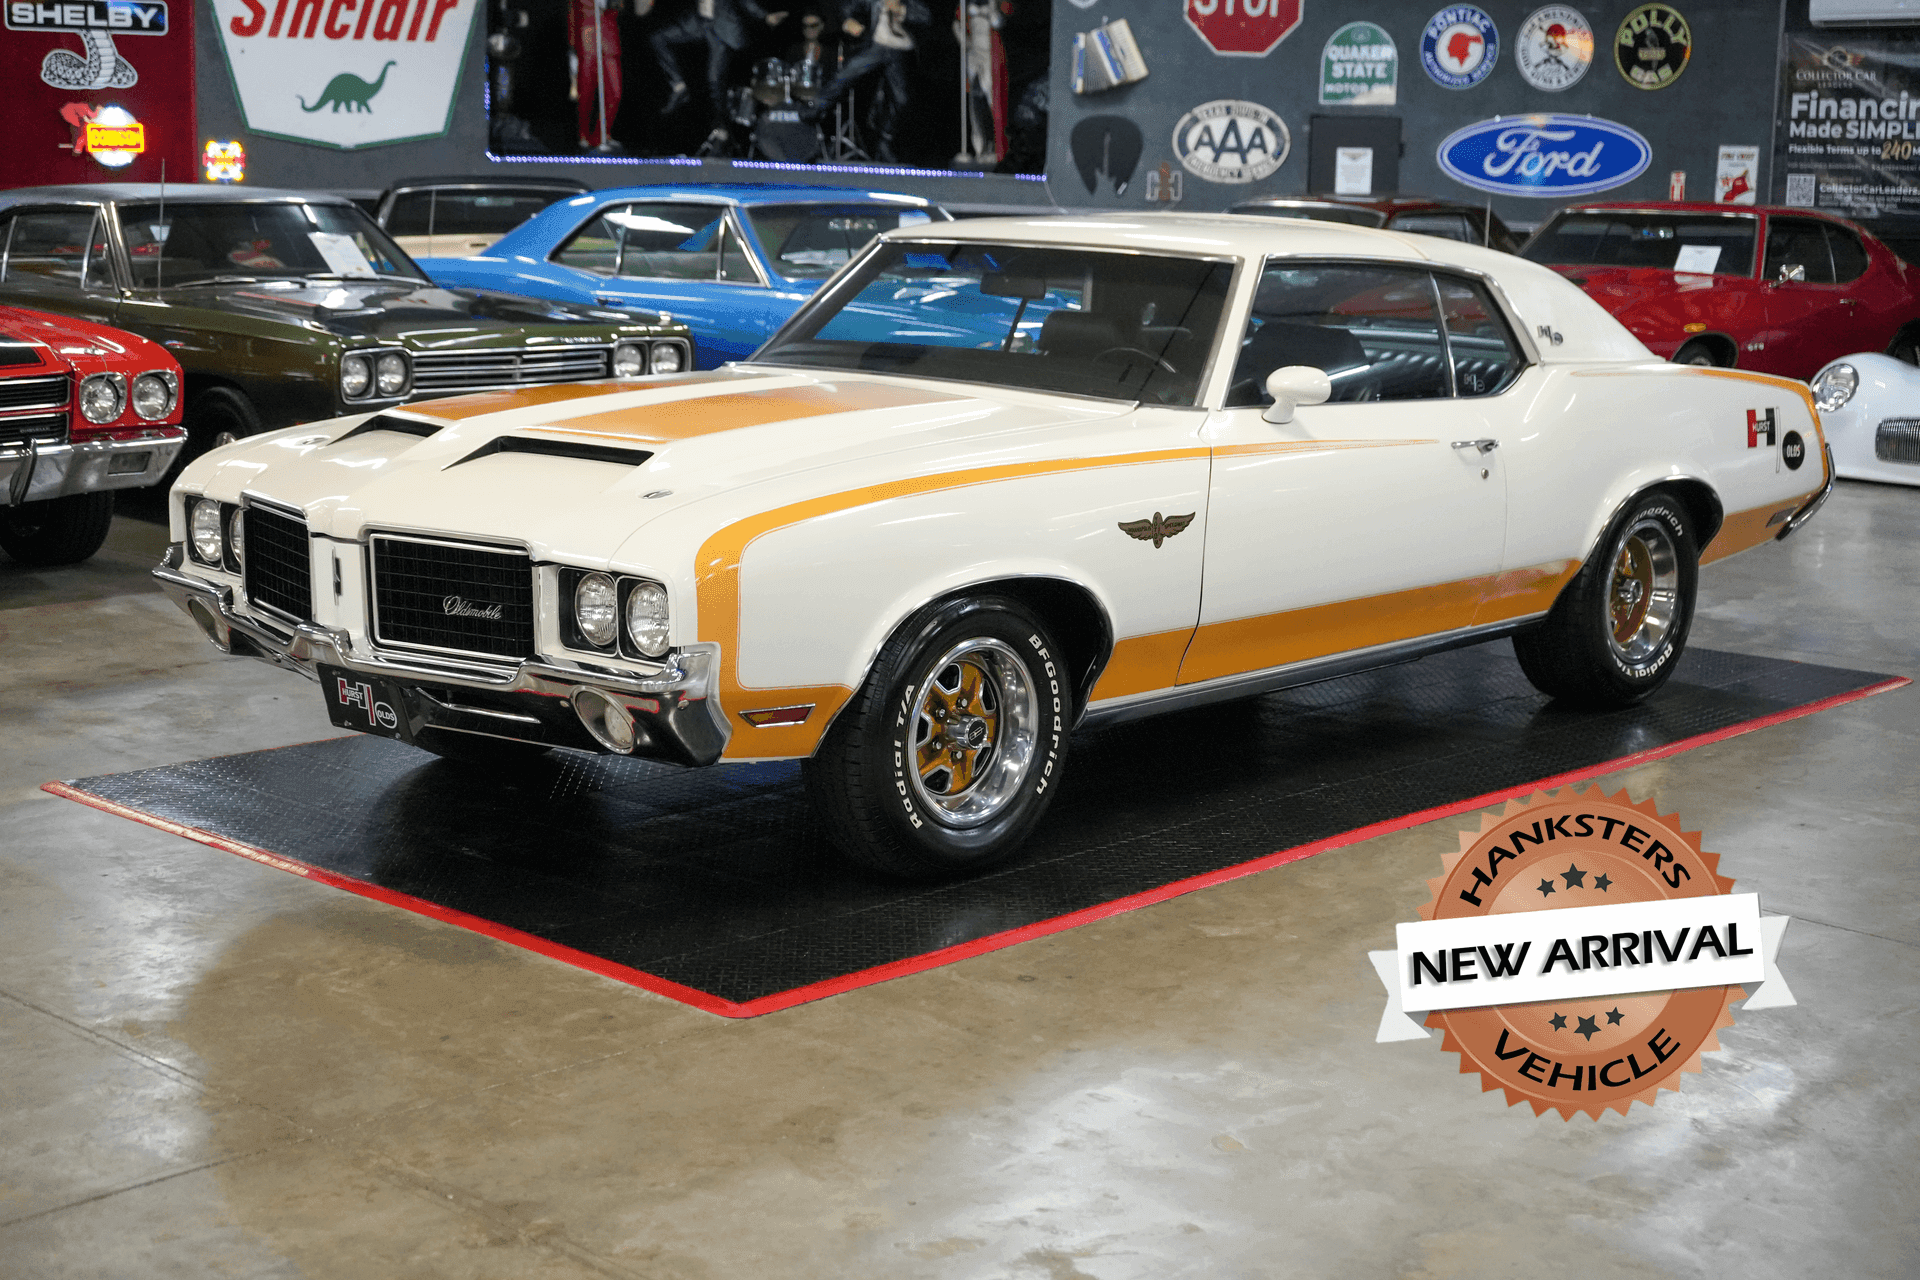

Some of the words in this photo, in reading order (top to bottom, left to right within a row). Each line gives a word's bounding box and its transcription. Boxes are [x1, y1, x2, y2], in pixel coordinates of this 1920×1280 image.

[12, 3, 158, 28] SHELBY
[230, 0, 457, 41] Sinclair
[1426, 9, 1491, 39] PONTIAC
[1619, 10, 1689, 47] POLLY
[1327, 45, 1397, 61] QUAKER
[1332, 62, 1387, 78] STATE
[1796, 69, 1853, 81] COLLECTOR
[1855, 69, 1877, 82] CAR
[1193, 118, 1268, 164] AAA
[1789, 120, 1843, 138] Made
[1845, 120, 1920, 140] SIMPL
[1483, 129, 1604, 177] Ford
[1788, 143, 1824, 154] Flexible
[1826, 144, 1855, 155] Terms
[1856, 146, 1869, 156] up
[1871, 145, 1881, 155] to
[1881, 140, 1912, 160] 240
[1752, 420, 1771, 432] HURST
[1786, 444, 1801, 458] OLDS
[443, 595, 502, 619] Oldsmobile
[1635, 643, 1673, 678] Radial
[342, 687, 363, 700] HURST
[376, 709, 395, 722] OLDS
[896, 685, 915, 727] T/A
[1028, 633, 1062, 795] BFGoodrich
[894, 740, 923, 829] Radial
